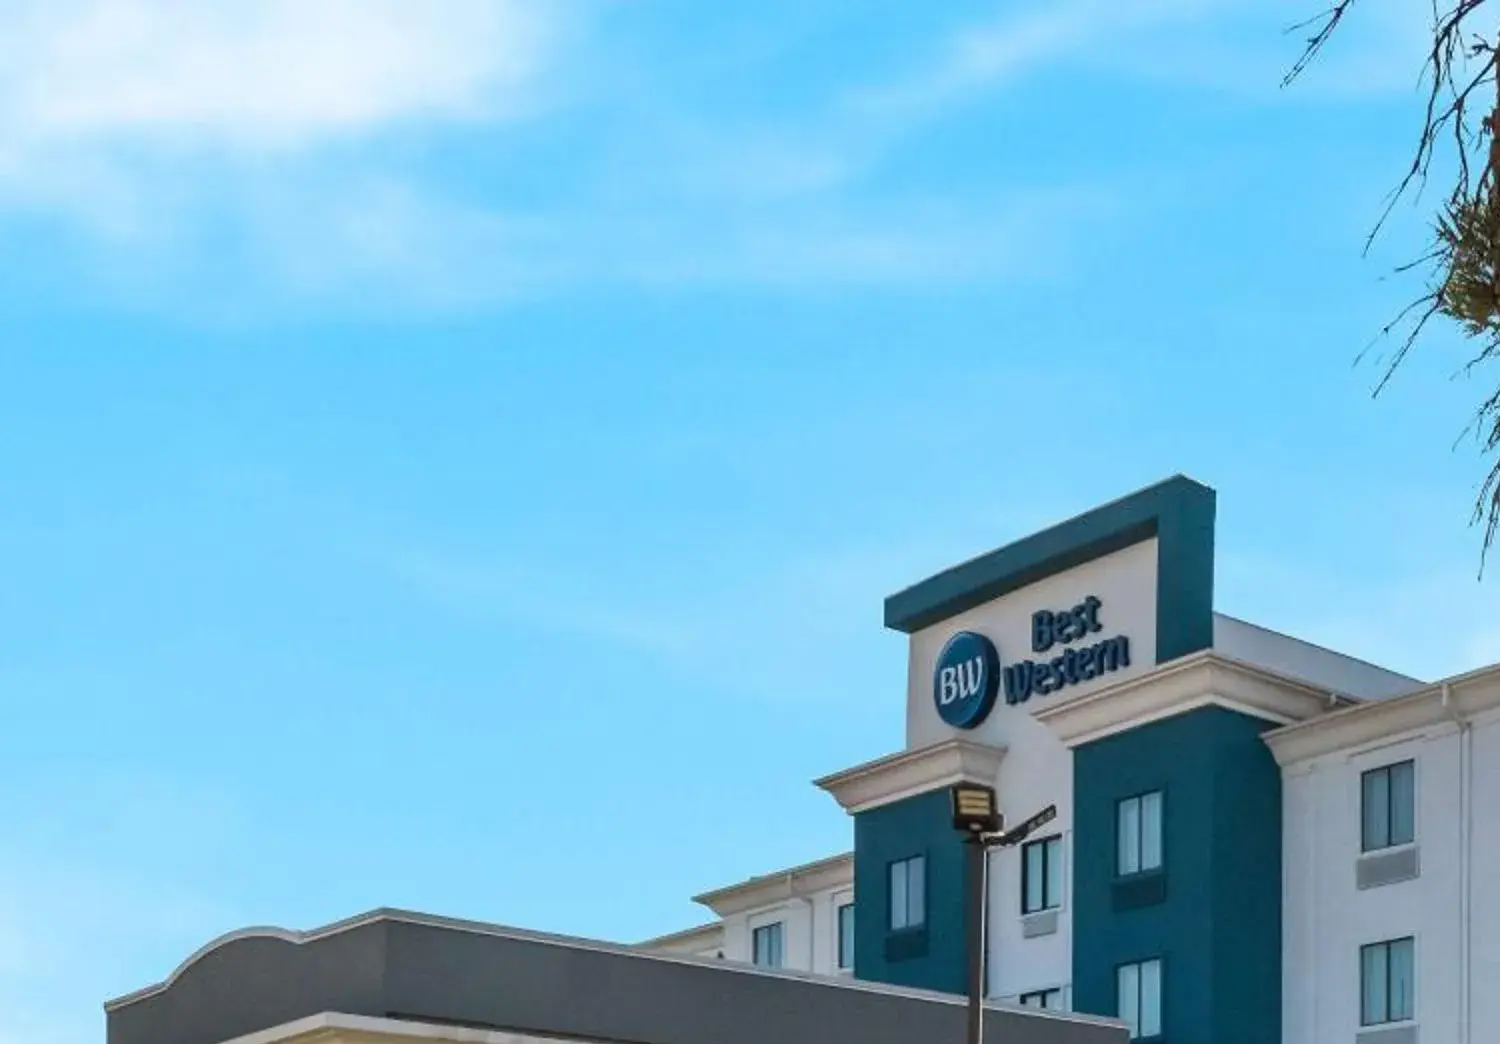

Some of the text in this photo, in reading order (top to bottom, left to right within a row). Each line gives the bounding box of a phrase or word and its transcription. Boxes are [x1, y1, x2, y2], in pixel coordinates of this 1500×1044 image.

[1032, 596, 1101, 651] Best
[940, 656, 983, 704] BW
[1004, 635, 1130, 705] Western
